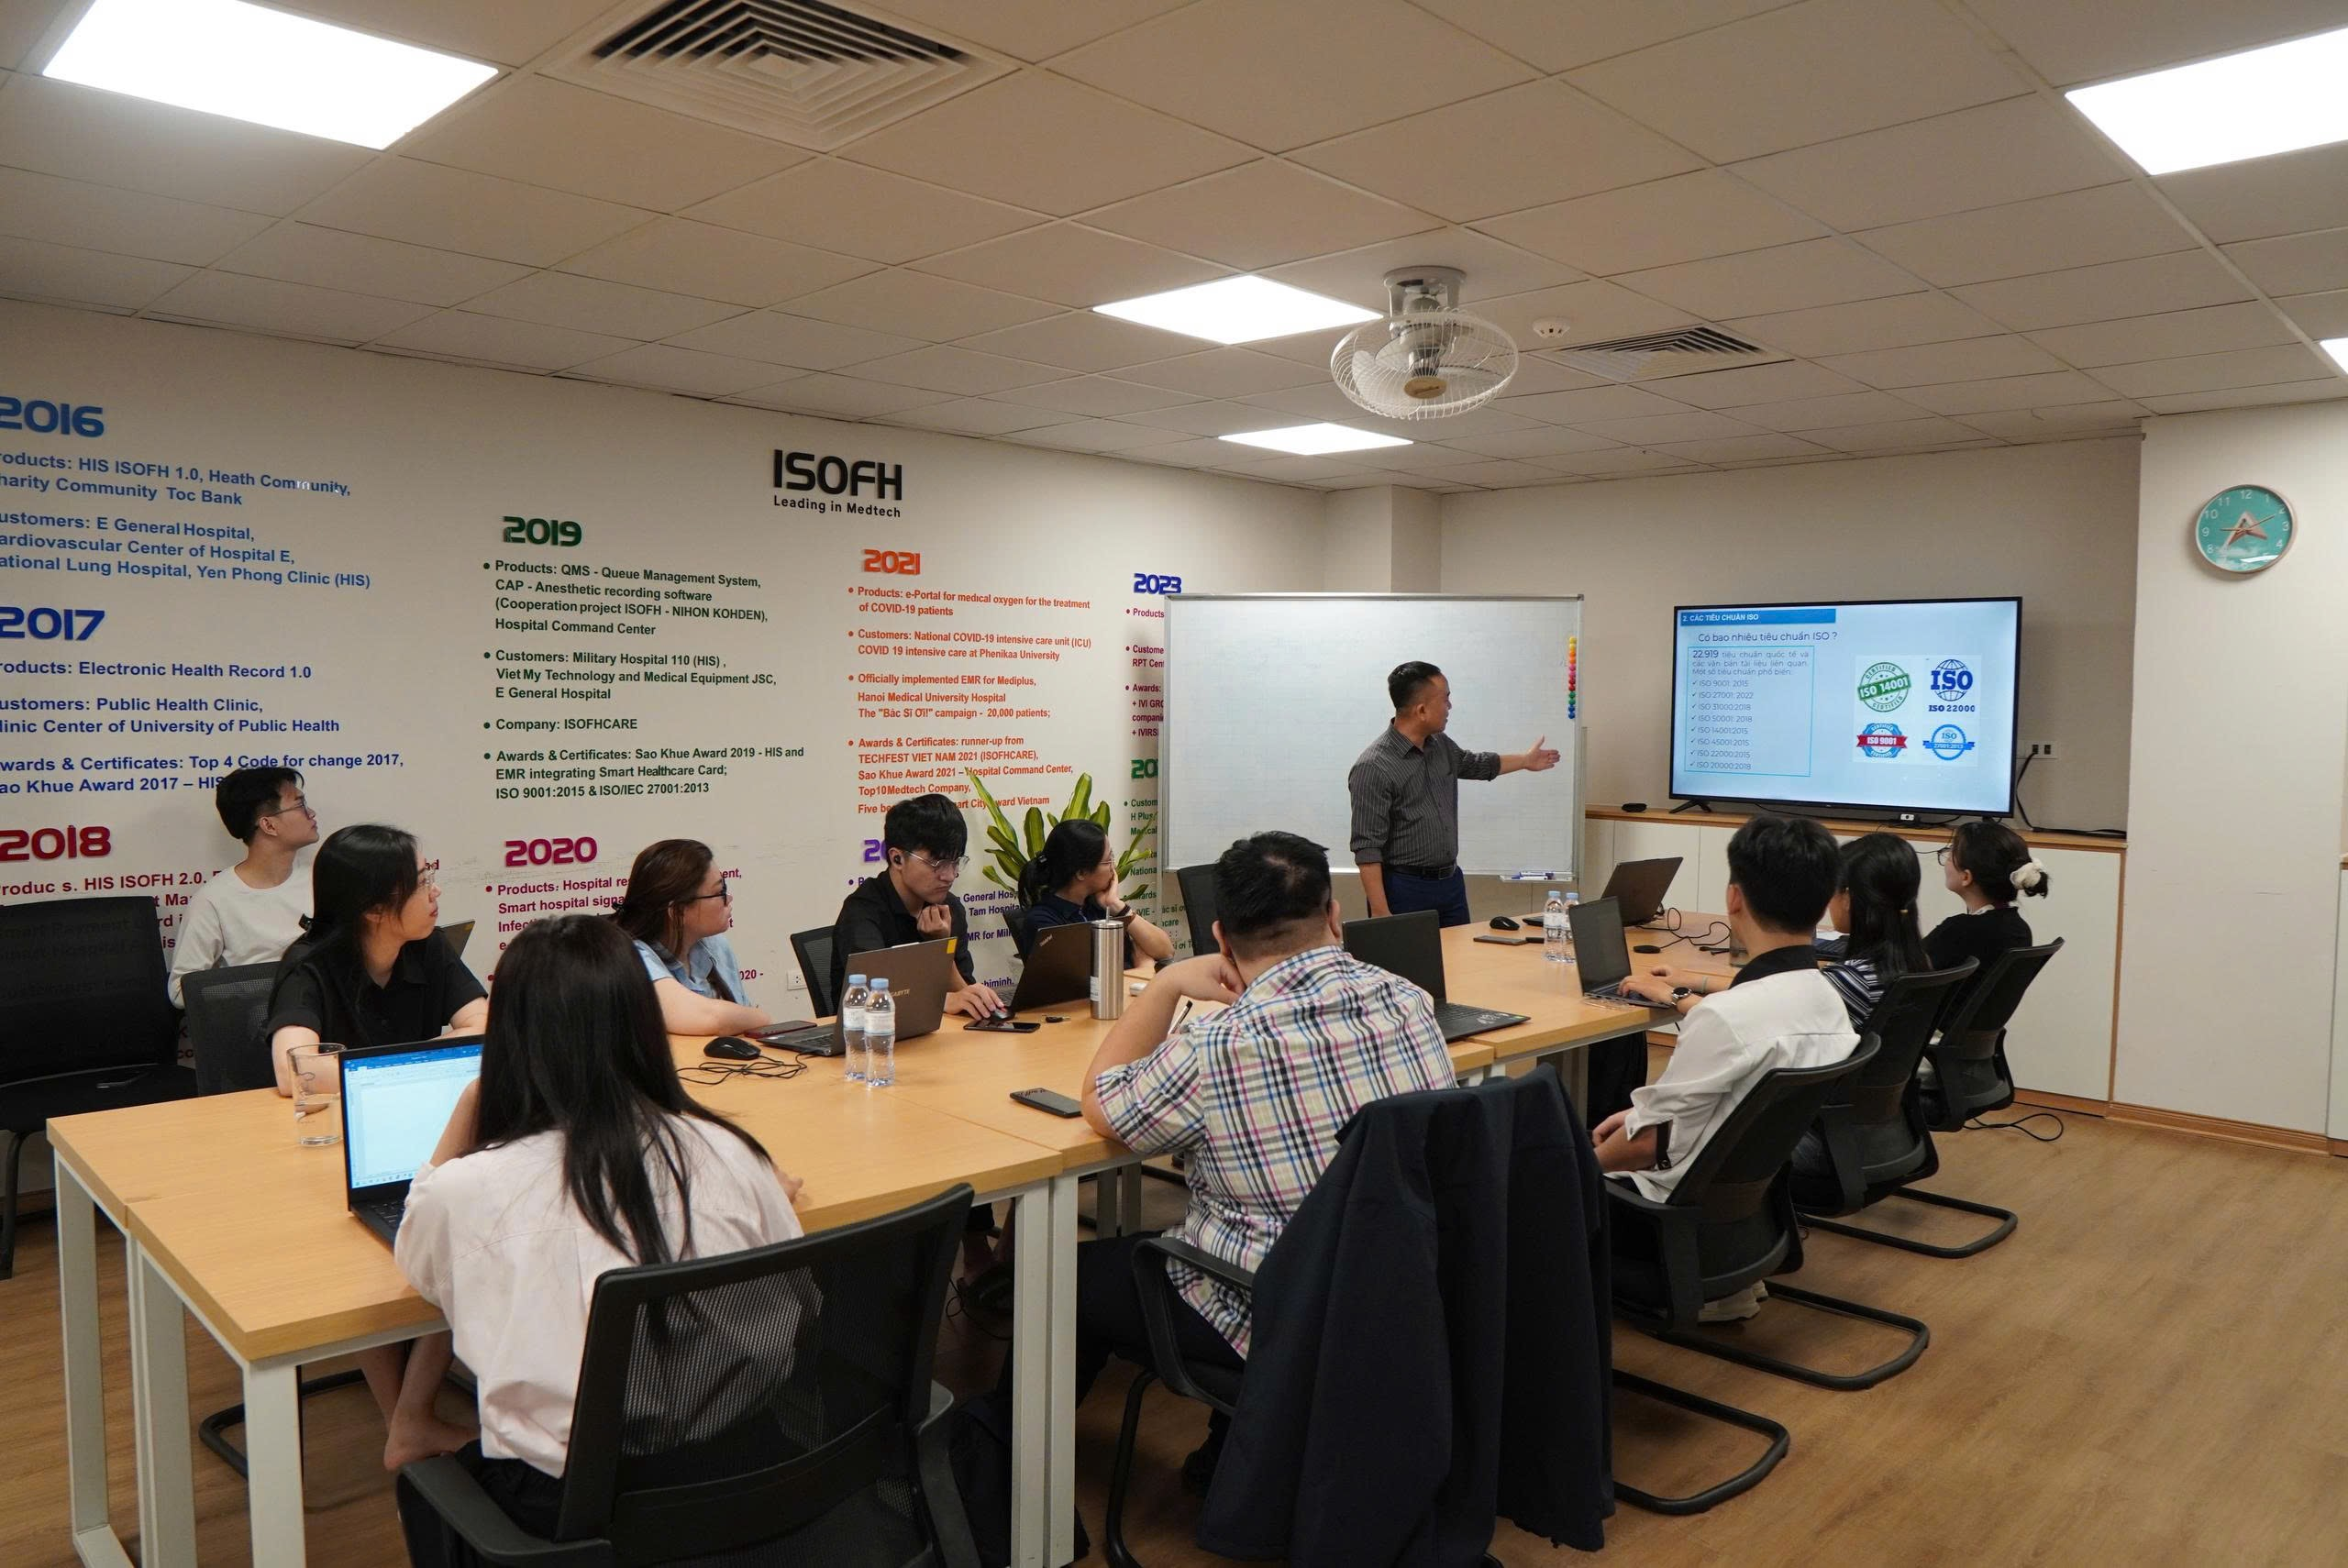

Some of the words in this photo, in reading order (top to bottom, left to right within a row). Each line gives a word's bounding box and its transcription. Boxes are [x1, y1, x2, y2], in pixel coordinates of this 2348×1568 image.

[0, 396, 105, 437] 2016
[79, 457, 109, 473] HIS
[116, 460, 169, 479] ISOFH
[175, 467, 204, 484] 1.0,
[209, 469, 256, 487] Heath
[773, 449, 903, 501] ISOFH
[2218, 498, 2230, 506] 11
[2240, 490, 2253, 500] 12
[774, 494, 825, 514] Leading
[831, 500, 842, 513] in
[847, 502, 901, 518] Medtech
[2205, 509, 2218, 519] 10
[0, 512, 90, 529] ustomers:
[97, 516, 108, 530] E
[115, 518, 180, 536] General
[184, 523, 254, 542] Hospital,
[502, 515, 581, 547] 2019
[2202, 527, 2210, 536] 9
[862, 548, 921, 575] 2021
[0, 554, 60, 570] ational
[67, 558, 111, 577] Lung
[117, 560, 191, 580] Hospital,
[197, 565, 227, 580] Yen
[232, 567, 282, 585] Phong
[287, 570, 330, 585] Clinic
[335, 573, 370, 590] (HIS)
[495, 559, 557, 575] Products:
[561, 564, 590, 577] QMS
[602, 567, 639, 580] Queue
[643, 569, 715, 585] Management
[718, 574, 760, 589] System,
[1134, 573, 1181, 594] 2023
[858, 586, 903, 599] Products:
[904, 589, 941, 601] e-Portal
[943, 591, 956, 602] for
[958, 592, 991, 603] medical
[993, 596, 1024, 607] oxygen
[1025, 596, 1037, 606] for
[1038, 597, 1051, 607] the
[1053, 599, 1090, 609] treatment
[495, 596, 577, 613] (Cooperation
[580, 602, 622, 616] project
[625, 603, 661, 616] ISOFH
[672, 605, 709, 618] NIHON
[713, 607, 768, 624] KOHDEN),
[0, 606, 105, 641] 2017
[858, 628, 912, 640] Customers:
[914, 630, 951, 642] National
[953, 633, 994, 644] COVID-19
[996, 634, 1034, 645] intensive
[1036, 637, 1053, 646] care
[1055, 636, 1069, 646] unit
[1071, 638, 1091, 648] (ICU)
[1712, 633, 1730, 642] bao
[1812, 632, 1830, 640] ISO
[495, 649, 569, 663] Customers:
[573, 651, 616, 667] Military
[620, 653, 668, 668] Hospital
[671, 655, 690, 666] 110
[693, 655, 720, 668] (HIS)
[79, 661, 166, 676] Electronic
[172, 663, 223, 677] Health
[229, 664, 284, 679] Record
[290, 666, 311, 679] 1.0
[496, 668, 521, 679] Viet
[523, 668, 541, 683] My
[545, 668, 615, 684] Technology
[618, 670, 640, 682] and
[644, 671, 687, 683] Medical
[691, 672, 749, 686] Equipment
[752, 673, 776, 686] JSC,
[1859, 685, 1877, 698] ISO
[1879, 677, 1909, 692] 14001
[1931, 670, 1974, 690] ISO
[858, 691, 885, 702] Hanoi
[887, 691, 923, 702] Medical
[925, 692, 969, 704] University
[971, 692, 1005, 704] Hospital
[0, 719, 37, 733] linic
[43, 719, 103, 733] Center
[108, 719, 126, 733] of
[131, 719, 214, 735] University
[218, 719, 235, 732] of
[239, 719, 287, 732] Public
[293, 719, 339, 732] Health
[496, 718, 559, 733] Company:
[564, 718, 637, 730] ISOFHCARE
[0, 757, 55, 772] wards
[61, 757, 74, 771] &
[81, 756, 183, 771] Certificates:
[189, 756, 219, 771] Top
[224, 756, 233, 768] 4
[238, 755, 279, 768] Code
[283, 755, 305, 767] for
[309, 754, 362, 769] change
[367, 754, 404, 768] 2017,
[496, 750, 544, 762] Awards
[548, 749, 558, 761] &
[559, 748, 631, 761] Certificates:
[636, 748, 658, 759] Sao
[660, 747, 690, 759] Khue
[692, 747, 727, 758] Award
[730, 747, 755, 758] 2019
[765, 746, 782, 757] HIS
[785, 746, 803, 757] and
[858, 753, 910, 764] TECHFEST
[912, 752, 933, 763] VIET
[935, 752, 956, 762] NAM
[958, 751, 977, 762] 2021
[980, 750, 1038, 763] (ISOFHCARE),
[496, 787, 519, 800] ISO
[523, 785, 585, 799] 9001:2015
[588, 785, 597, 797] &
[600, 784, 644, 796] ISO/IEC
[648, 782, 709, 795] 27001:2013
[928, 783, 970, 795] Company,
[1017, 797, 1050, 808] Vietnam
[0, 824, 112, 861] 2018
[504, 836, 598, 867] 2020
[84, 876, 114, 891] HIS
[120, 873, 173, 889] ISOFH
[497, 881, 559, 896] Products:
[563, 877, 612, 892] Hospital
[499, 900, 536, 914] Smart
[540, 896, 589, 911] hospital
